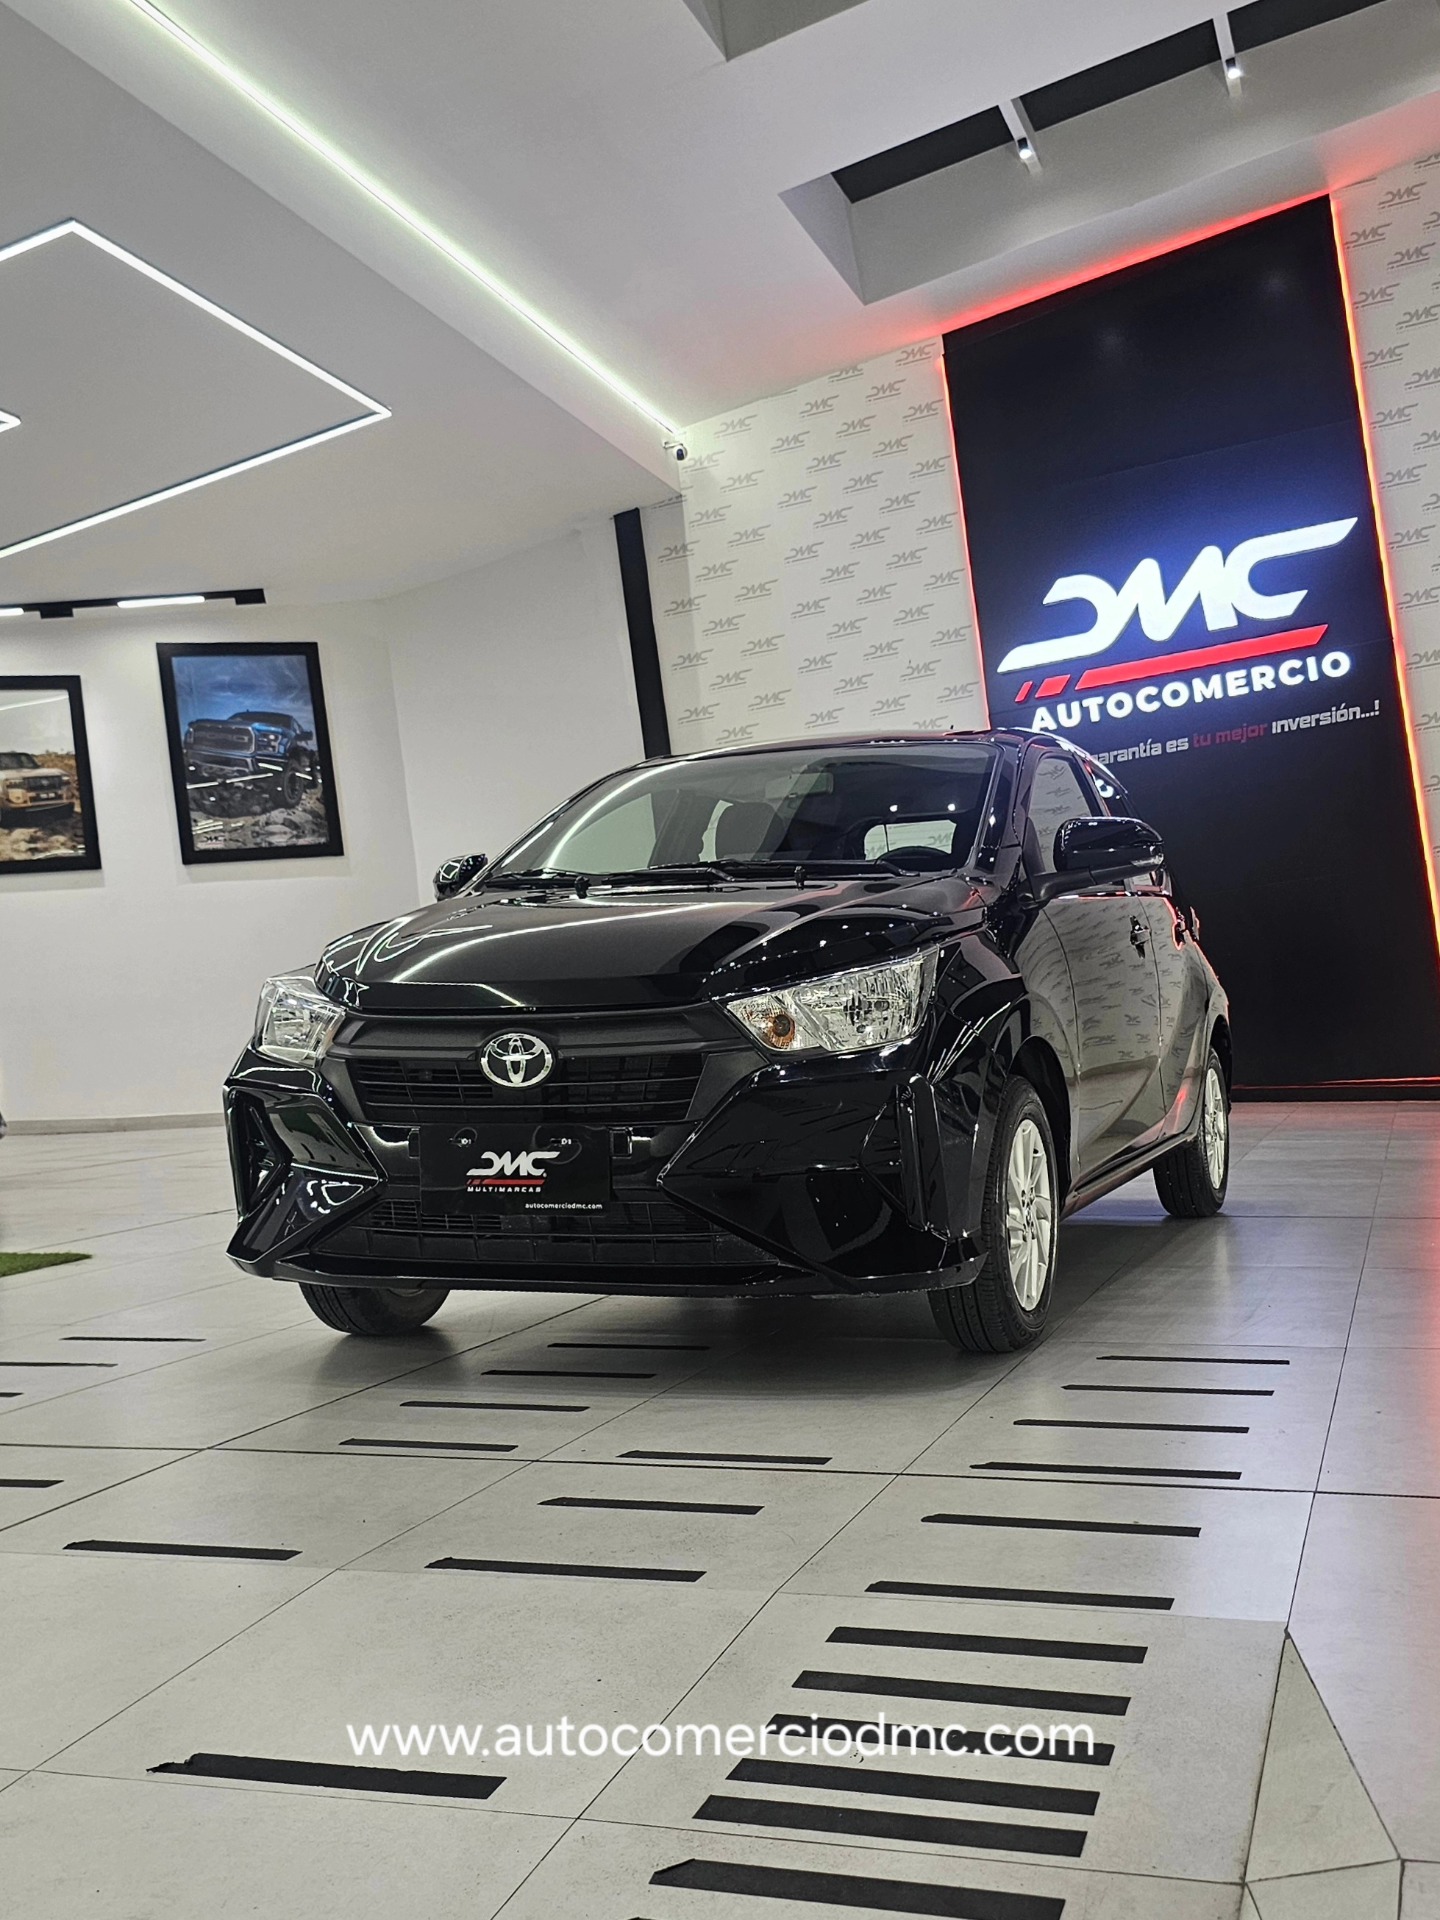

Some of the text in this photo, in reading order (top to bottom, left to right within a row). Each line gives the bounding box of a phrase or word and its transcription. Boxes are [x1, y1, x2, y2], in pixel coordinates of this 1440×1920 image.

[997, 517, 1358, 673] DMC
[1031, 651, 1351, 732] AUTOCOMERCIO
[1166, 737, 1189, 753] es
[1193, 732, 1212, 748] tu
[1215, 723, 1268, 744] mejor
[466, 1151, 560, 1176] DMC
[525, 1202, 603, 1210] autocomerciodmc.com
